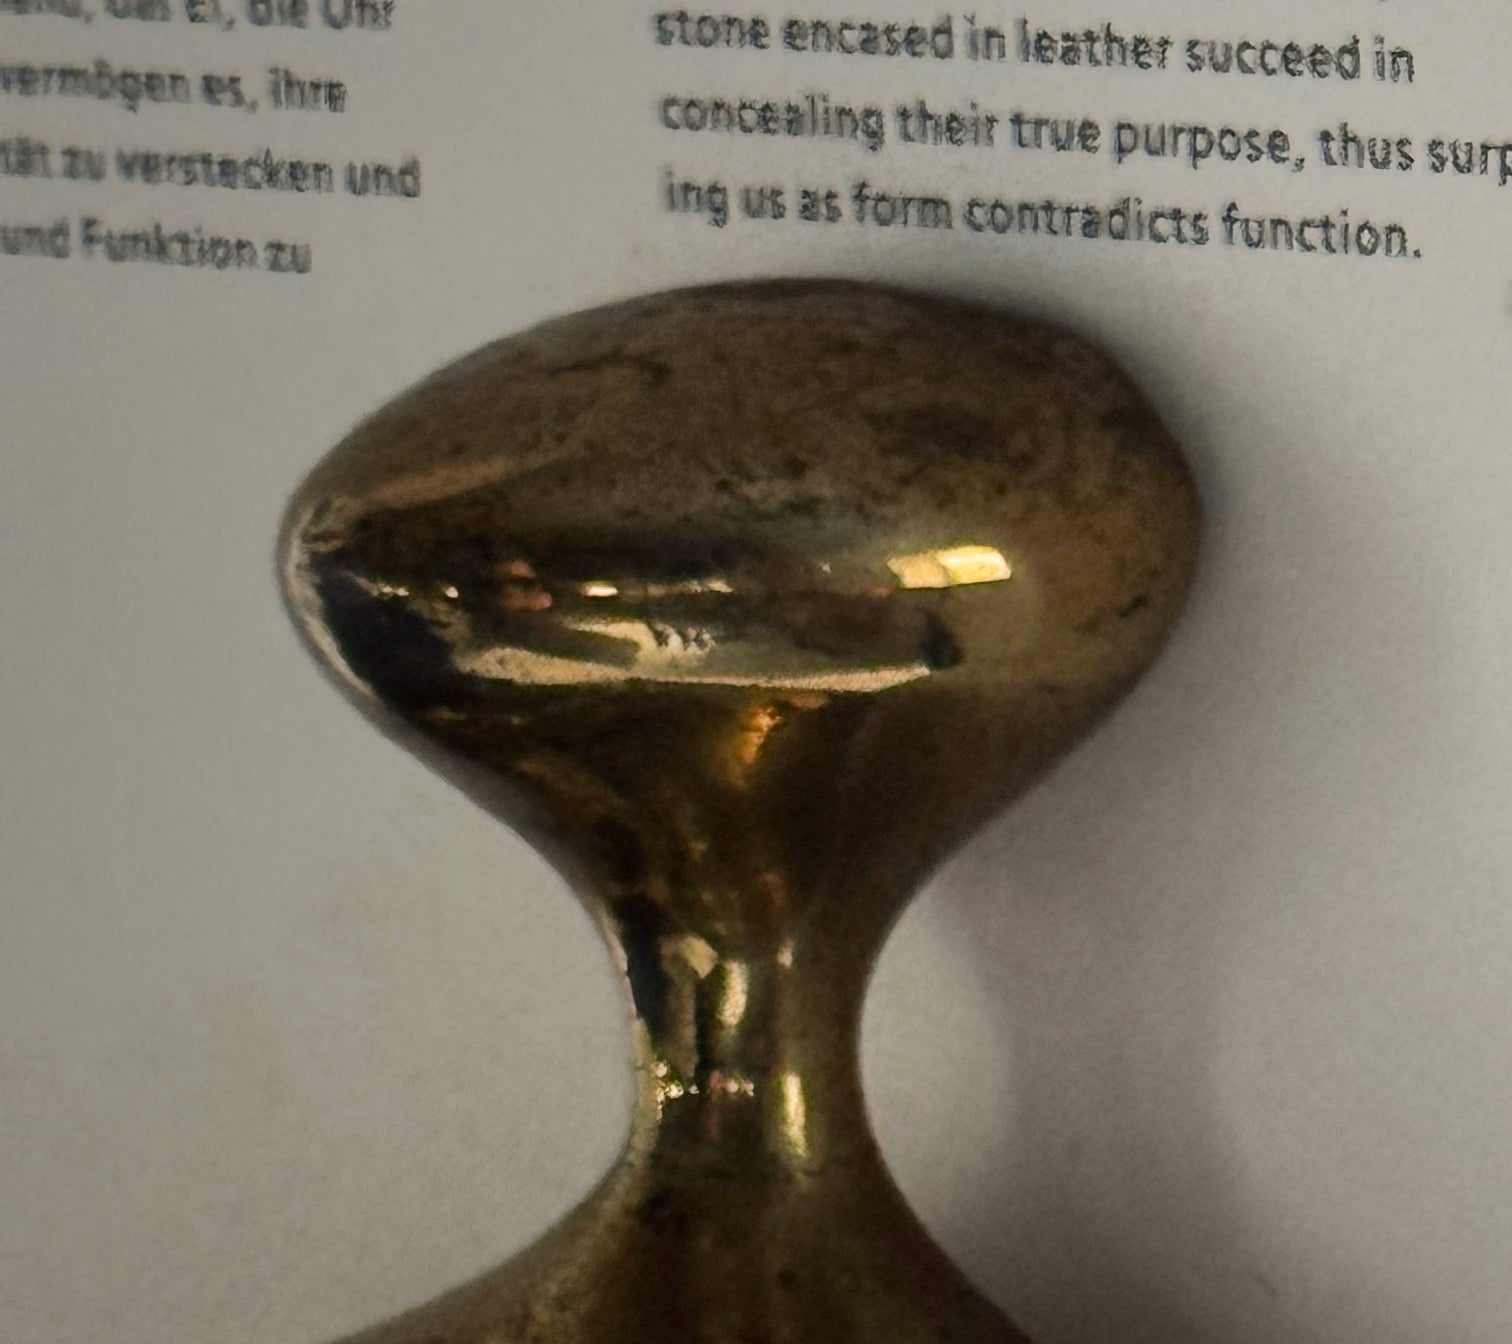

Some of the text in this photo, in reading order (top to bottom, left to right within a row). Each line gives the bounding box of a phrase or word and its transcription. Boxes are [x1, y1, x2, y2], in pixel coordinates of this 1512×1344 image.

[655, 11, 1415, 84] stone encased in leather succeed in
[202, 73, 259, 113] es,
[662, 92, 885, 152] concealing
[897, 98, 999, 147] their
[1008, 112, 1101, 154] true
[1116, 121, 1305, 172] purpose,
[1319, 121, 1415, 171] thus
[115, 147, 334, 193] verstecken
[344, 155, 421, 198] und
[665, 165, 1421, 258] ing us as form contradicts function.
[81, 216, 259, 268] Funktion
[264, 240, 312, 274] zu
